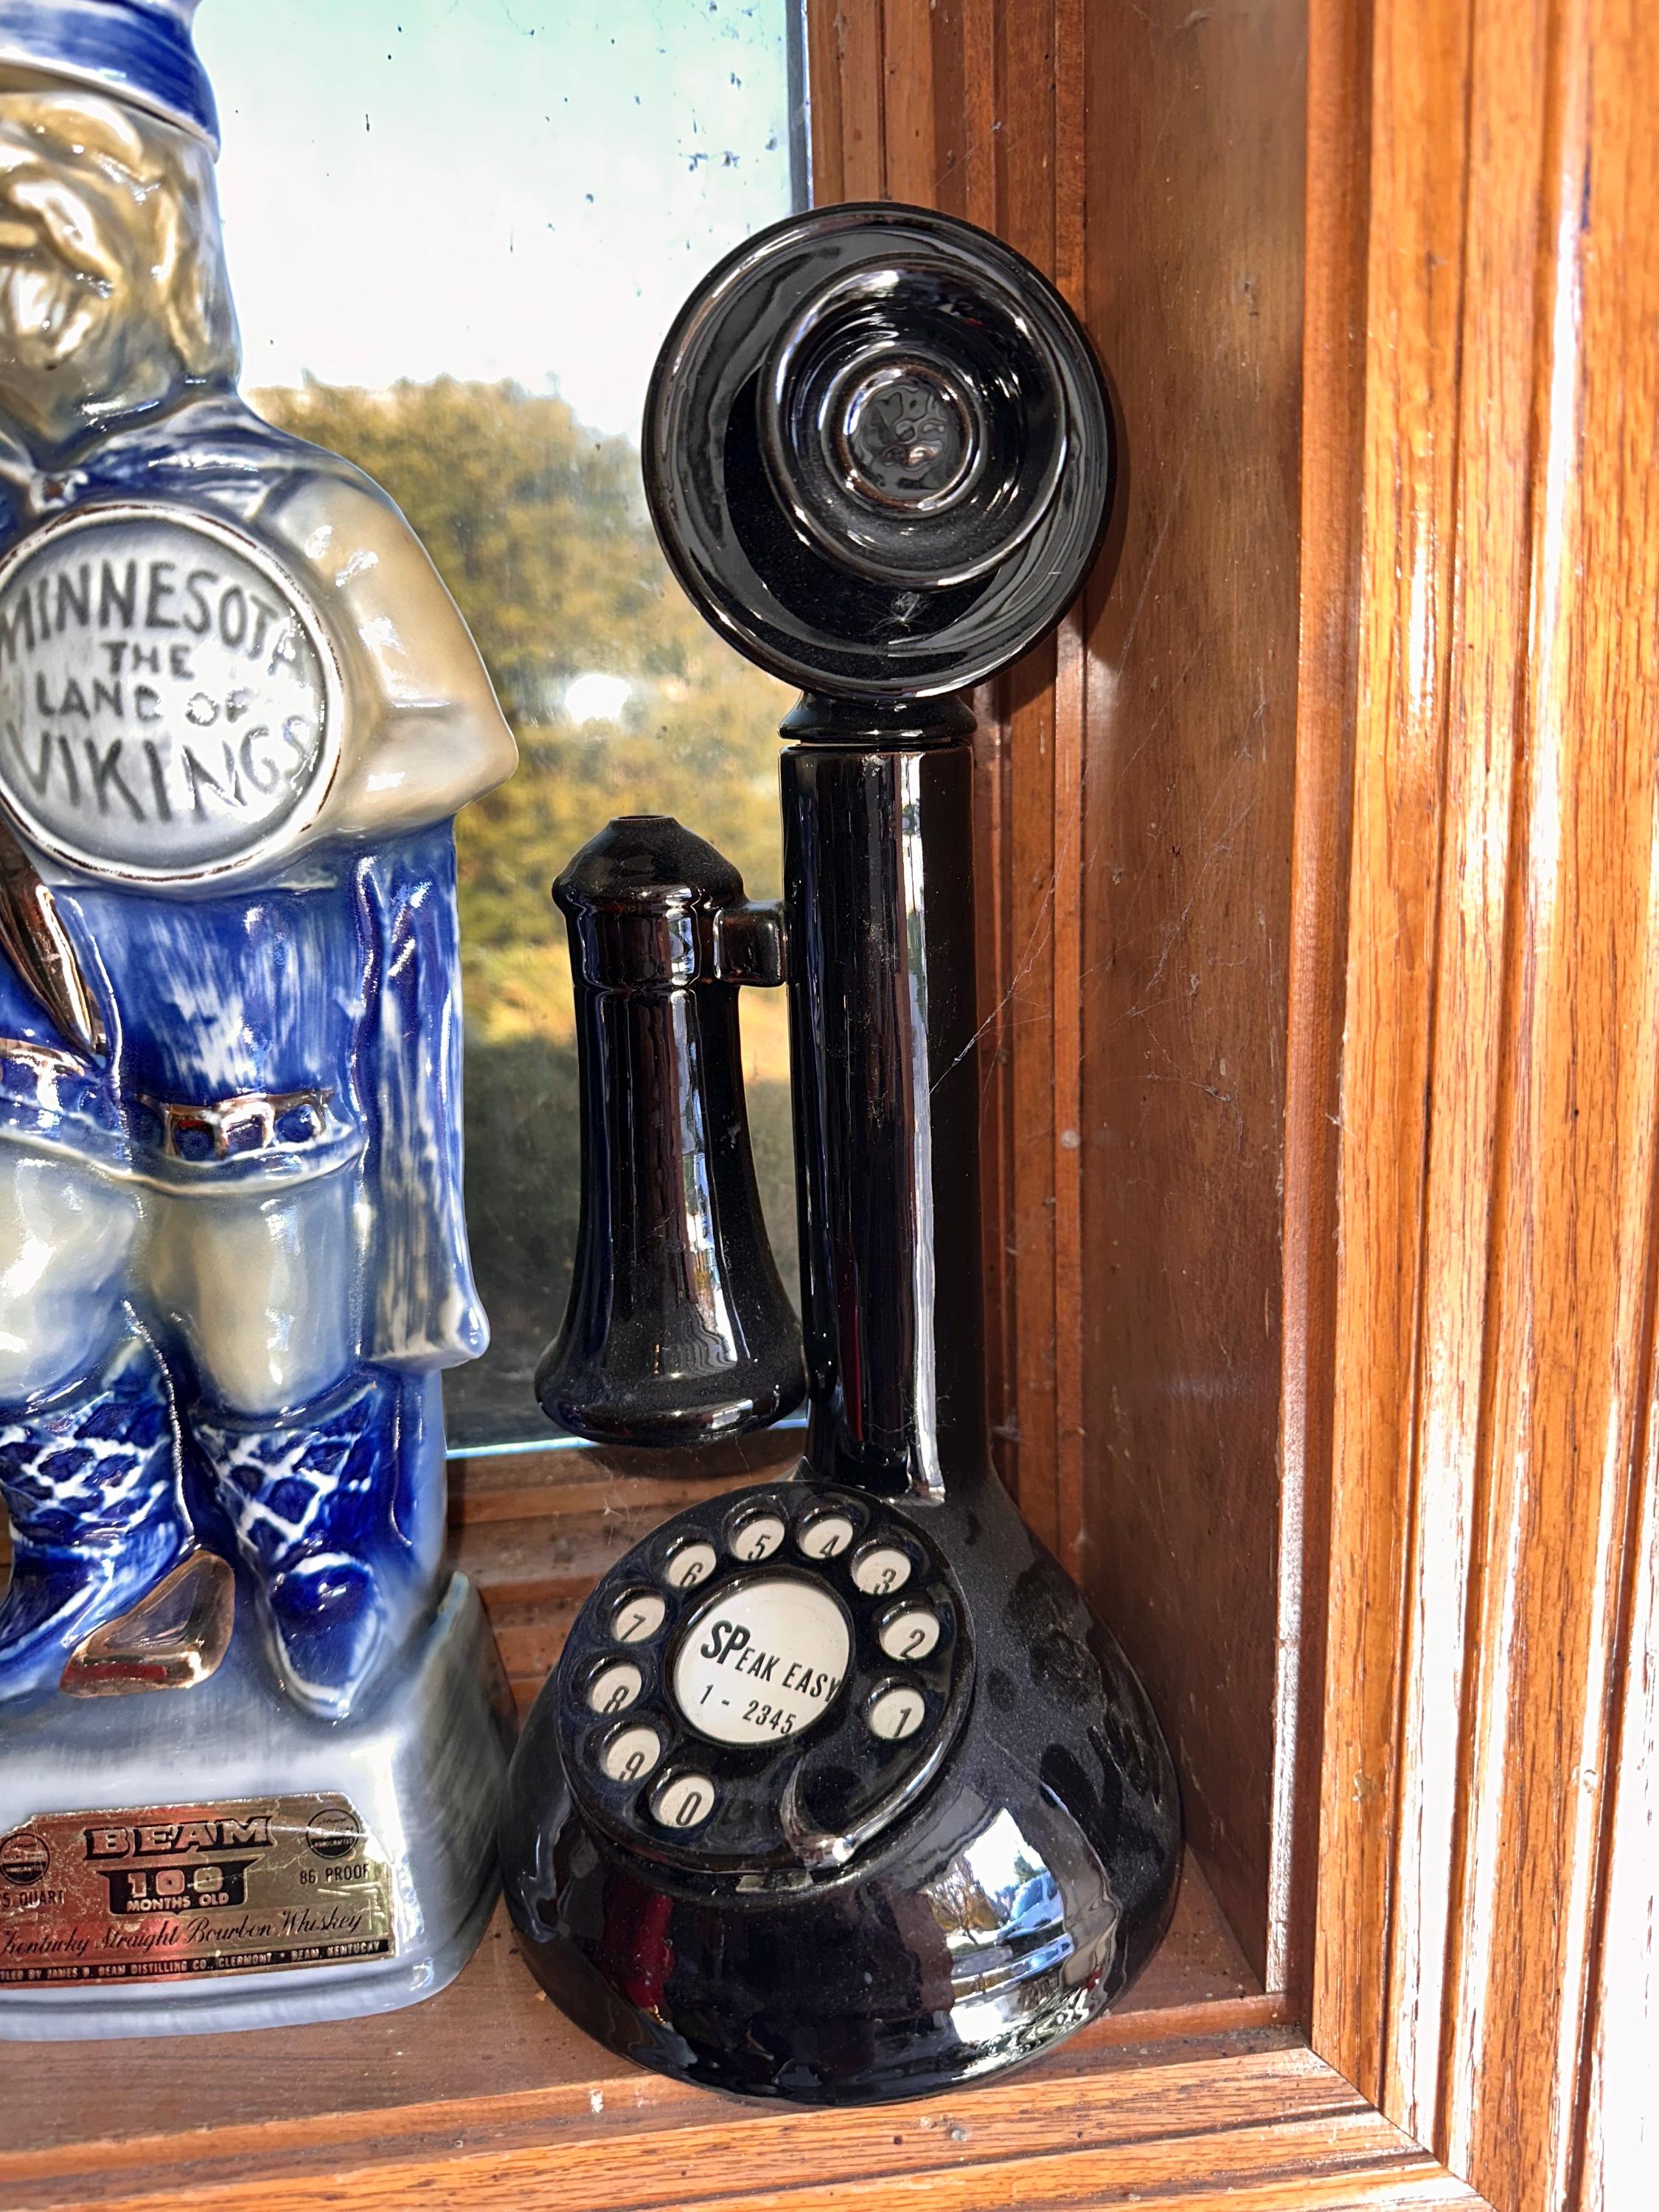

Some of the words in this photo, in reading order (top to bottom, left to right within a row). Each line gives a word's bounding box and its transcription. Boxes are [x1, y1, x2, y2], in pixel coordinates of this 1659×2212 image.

[0, 558, 305, 686] MINNESOTA
[100, 640, 195, 681] THE
[36, 671, 164, 723] LAND
[185, 686, 255, 727] OF
[6, 714, 311, 824] VIKINGS
[746, 1534, 771, 1560] 5
[819, 1534, 840, 1557] 4
[678, 1562, 703, 1587] 6
[873, 1568, 897, 1596] 3
[619, 1613, 647, 1641] 7
[899, 1628, 926, 1659] 2
[782, 1661, 844, 1703] EASY
[602, 1685, 630, 1713] 8
[700, 1684, 714, 1705] 1
[742, 1699, 797, 1735] 2345
[892, 1707, 911, 1738] 1
[619, 1750, 646, 1780] 9
[675, 1790, 702, 1826] 0
[83, 1815, 276, 1860] BEAM
[299, 1869, 318, 1885] 86
[325, 1864, 369, 1882] PROOF
[19, 1890, 64, 1907] QUART
[126, 1896, 191, 1912] MONTHS
[198, 1892, 229, 1906] OLD
[2, 1927, 90, 1957] Kentucky
[95, 1919, 179, 1955] Straight
[184, 1914, 273, 1944] Bourbon
[278, 1905, 363, 1937] Whiskey
[47, 1967, 78, 1979] JAMES
[98, 1964, 126, 1977] BEAM
[131, 1961, 187, 1975] DISTILLING
[218, 1952, 272, 1968] CLERMONT
[327, 1941, 380, 1956] KENTUCKY
